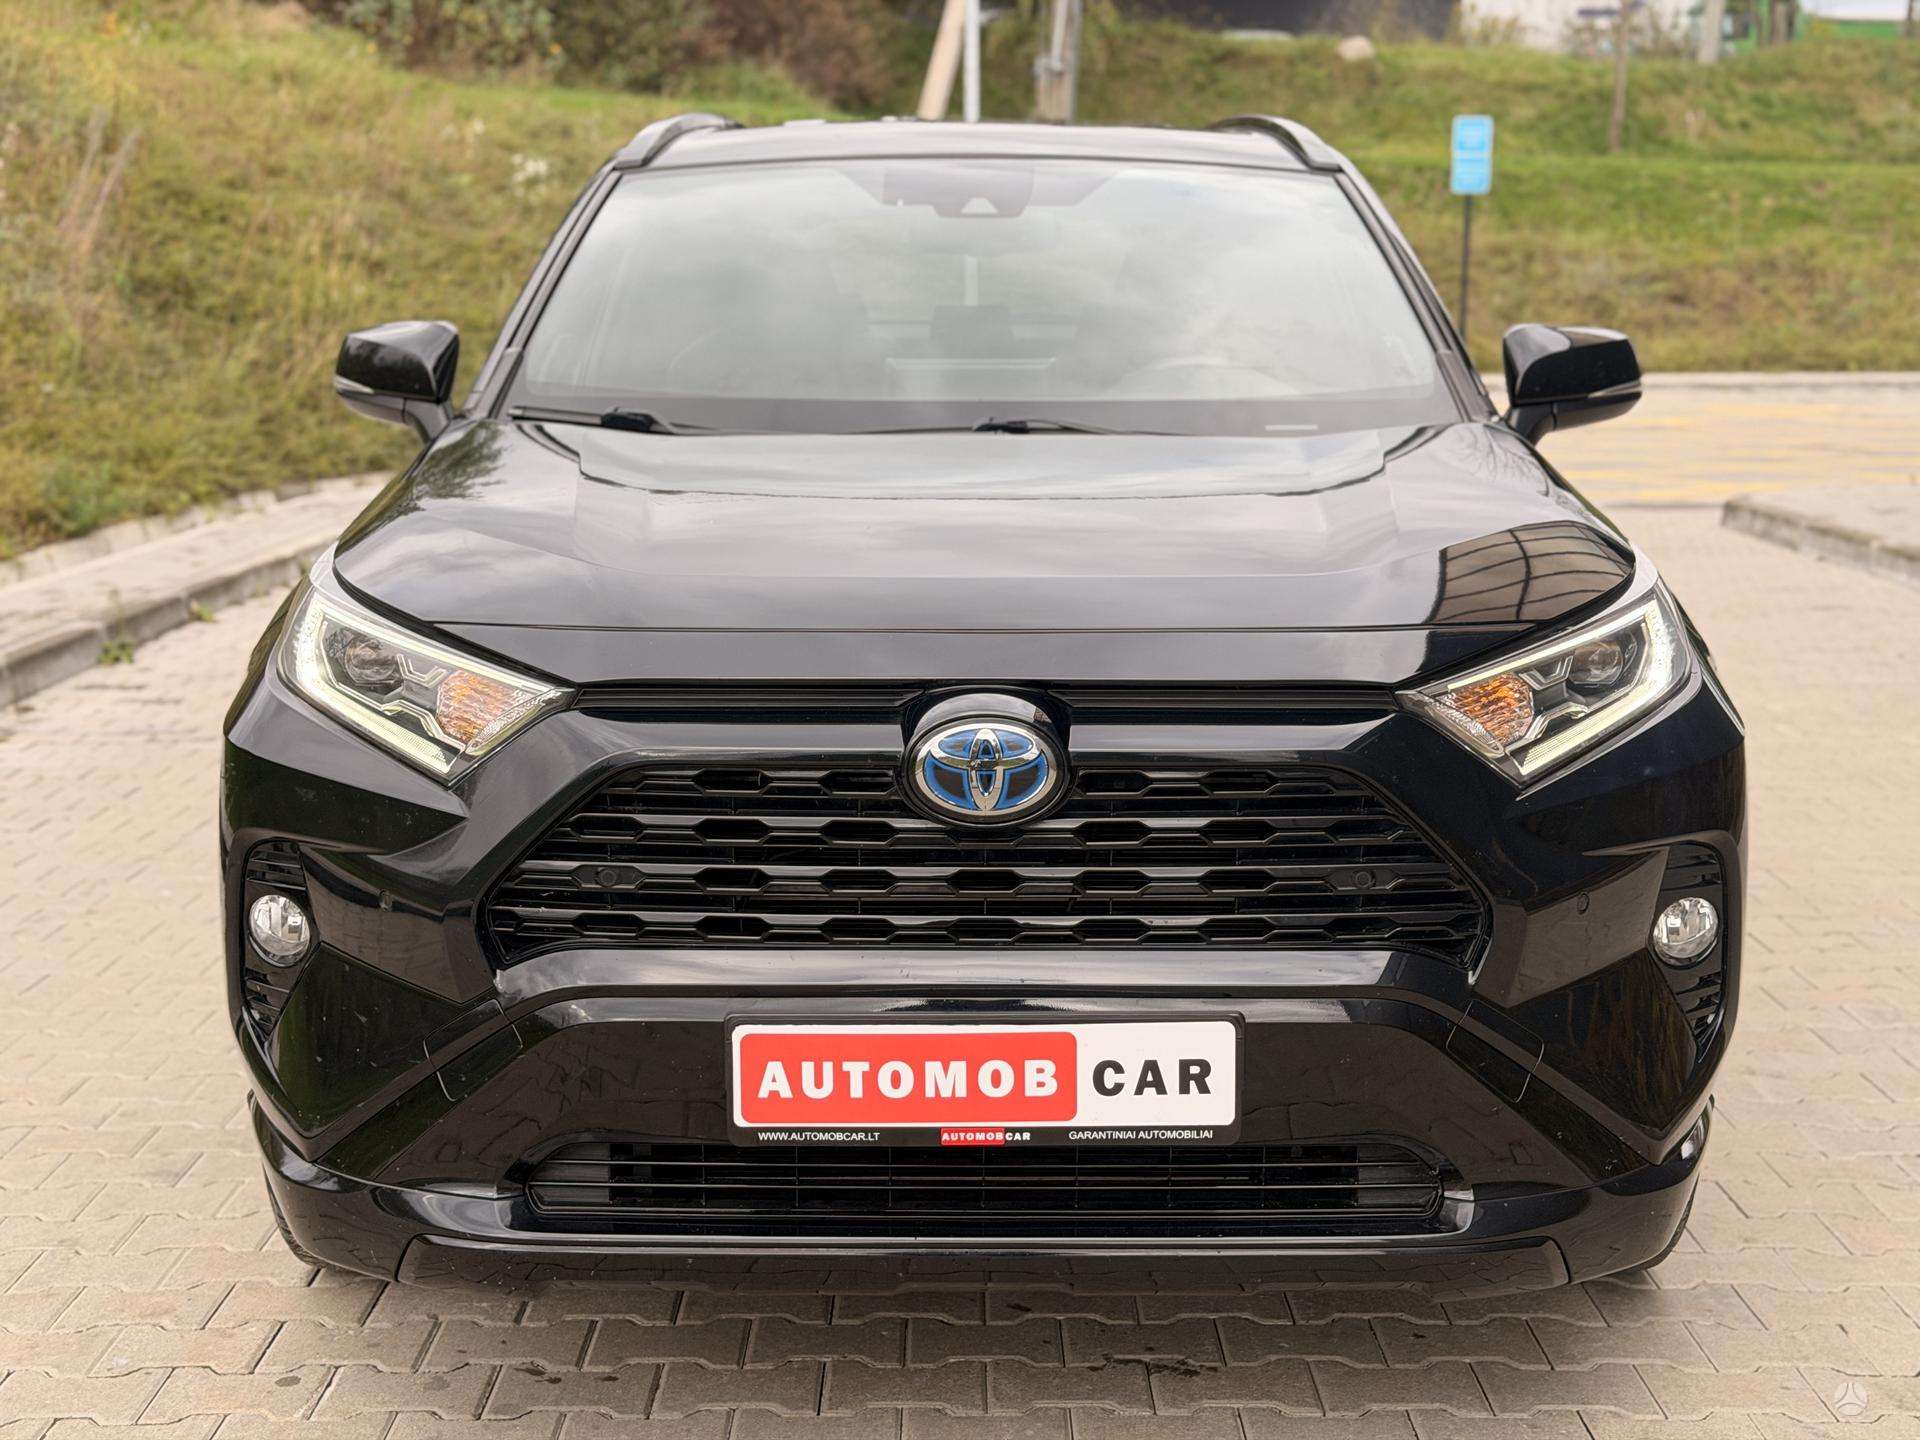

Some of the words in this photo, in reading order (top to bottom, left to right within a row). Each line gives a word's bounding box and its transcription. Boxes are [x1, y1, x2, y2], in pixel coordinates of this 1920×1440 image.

[757, 1059, 1058, 1100] AUTOMOB
[1092, 1058, 1212, 1097] CAR
[758, 1131, 880, 1142] WWW.AUTOMOBCAR.LT
[1069, 1129, 1136, 1141] GARANTINIAI
[1138, 1129, 1213, 1140] AUTOMOBILIAI
